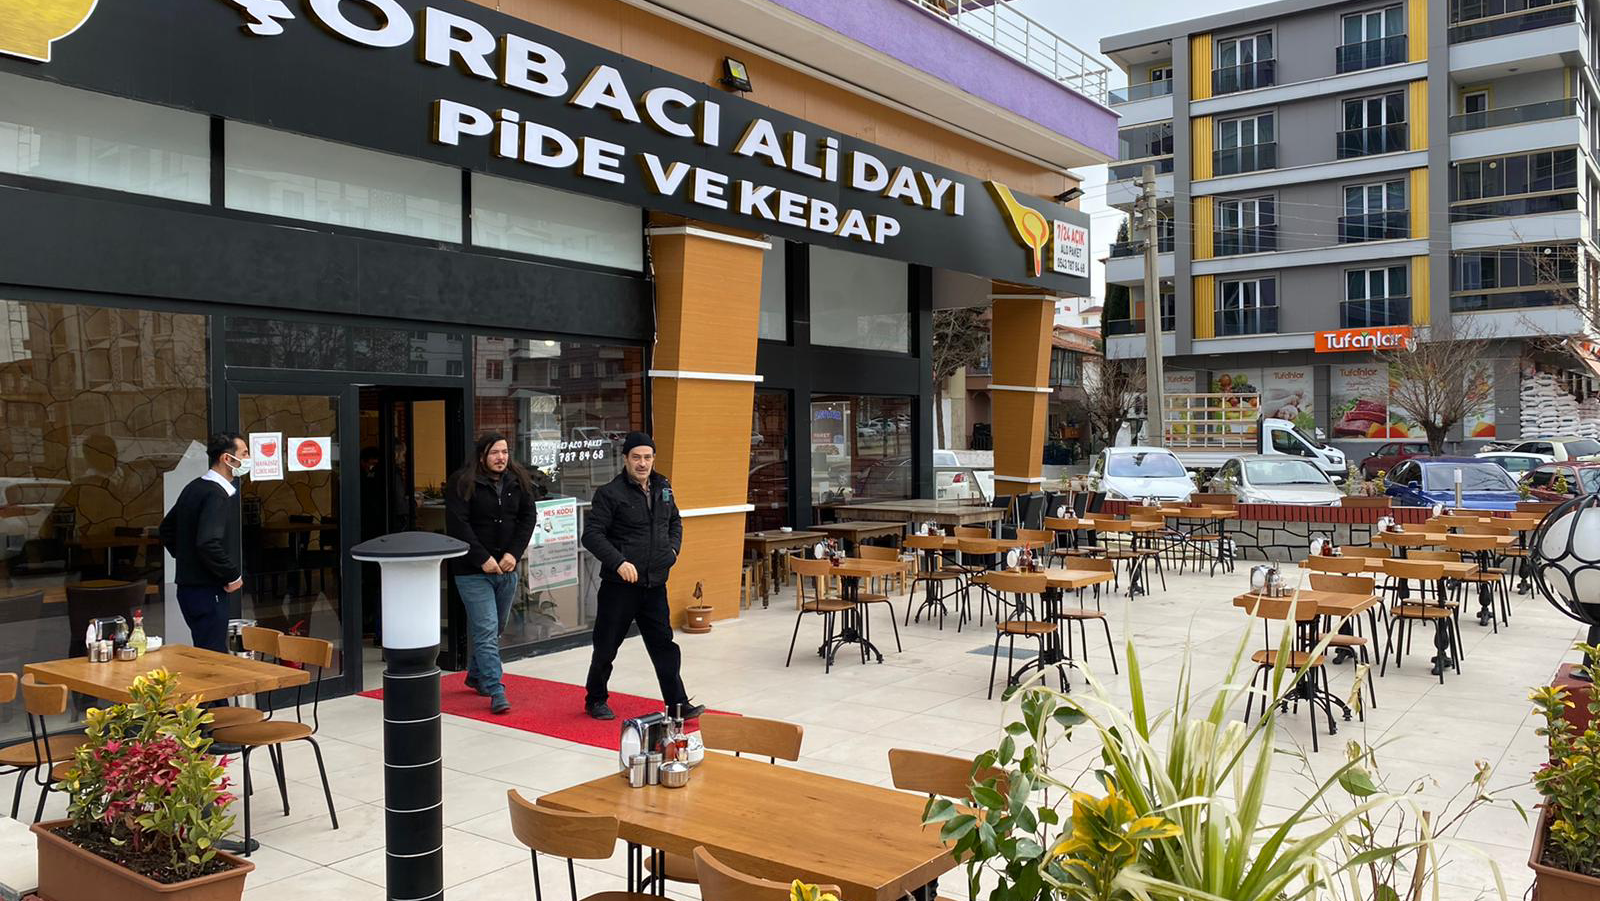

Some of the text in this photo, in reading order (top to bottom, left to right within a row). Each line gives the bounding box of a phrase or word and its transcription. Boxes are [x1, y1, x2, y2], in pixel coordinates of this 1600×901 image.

[851, 150, 965, 216] DAYI
[642, 152, 729, 210] VE
[739, 180, 901, 244] KEBAP
[1057, 224, 1070, 241] 7/24
[1069, 245, 1082, 258] PAKET
[1323, 330, 1402, 349] Tufanlar
[1273, 371, 1304, 380] Tufanlar
[1339, 367, 1378, 378] Tufanlar
[559, 451, 577, 462] 787
[579, 450, 590, 461] 84
[592, 449, 605, 460] 68
[543, 509, 555, 517] HES
